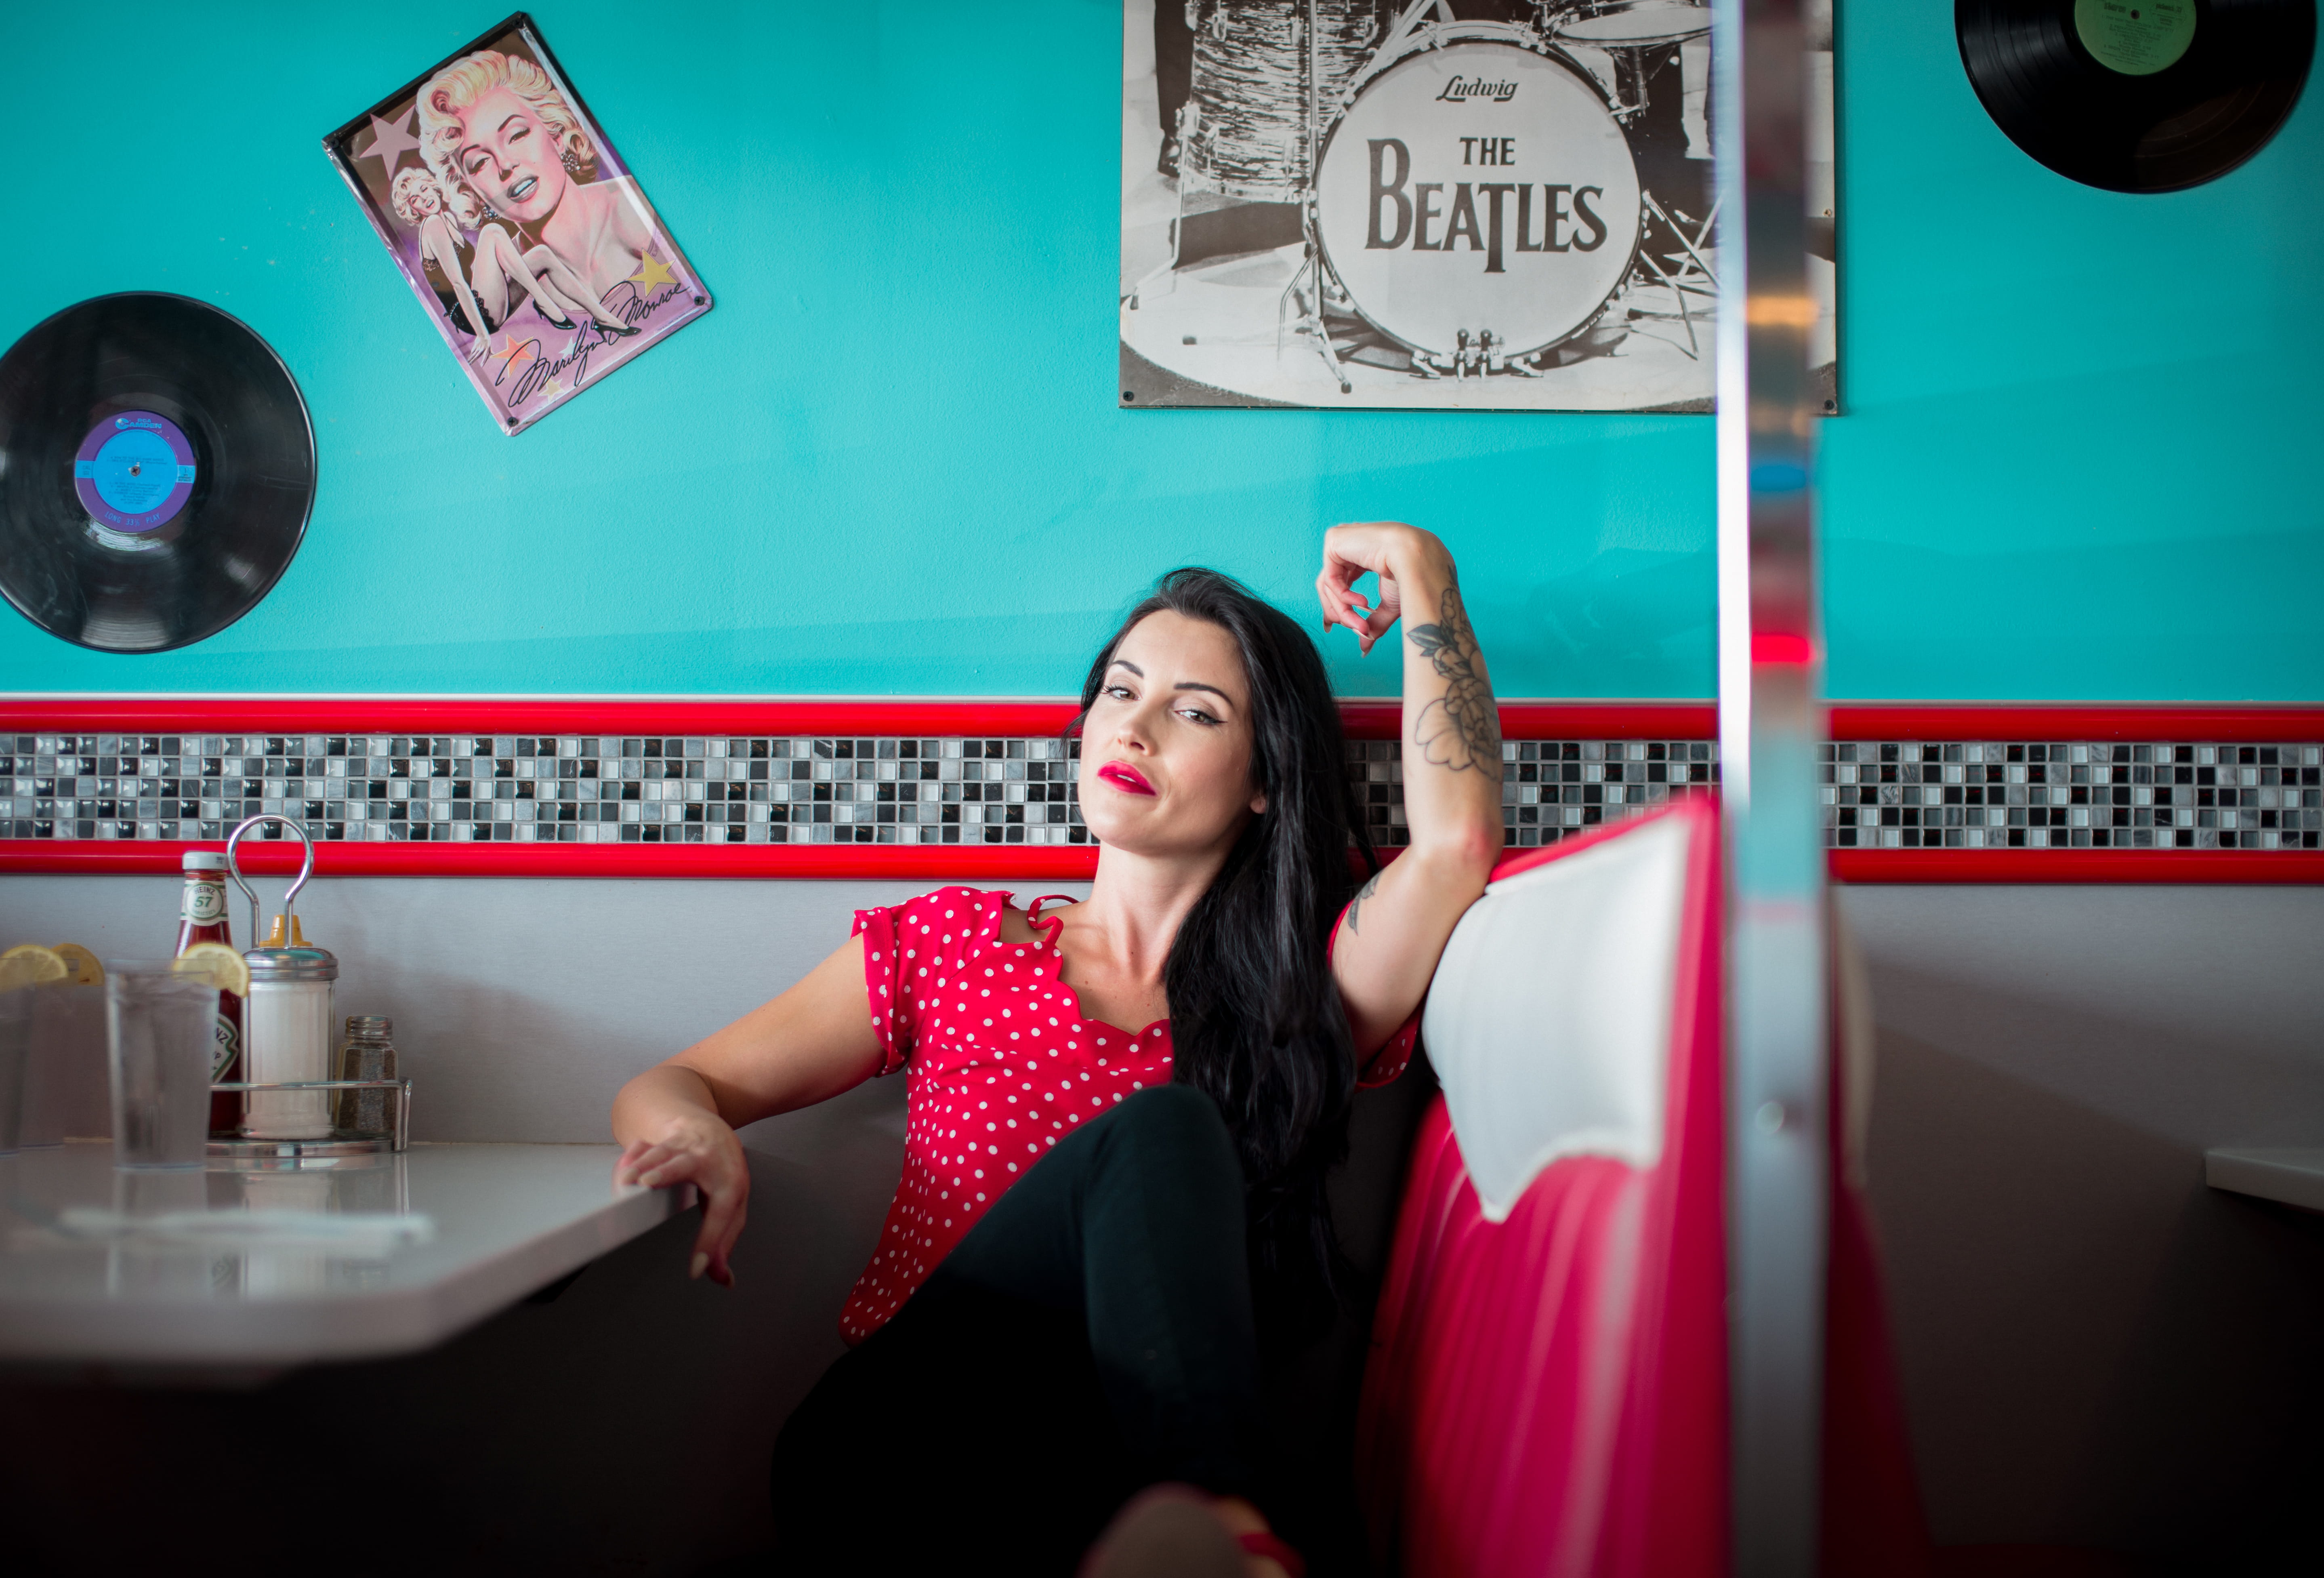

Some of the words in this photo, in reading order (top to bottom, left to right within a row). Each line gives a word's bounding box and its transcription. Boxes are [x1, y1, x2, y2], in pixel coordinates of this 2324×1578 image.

[1435, 75, 1519, 102] Ludwig
[1459, 137, 1516, 166] THE
[1364, 137, 1608, 274] BEATLES
[495, 320, 607, 407] Marilyn
[591, 280, 691, 345] Monroe
[105, 511, 122, 523] LONG
[146, 513, 160, 524] PLAY
[194, 896, 213, 907] 57
[195, 886, 215, 895] HEINZ
